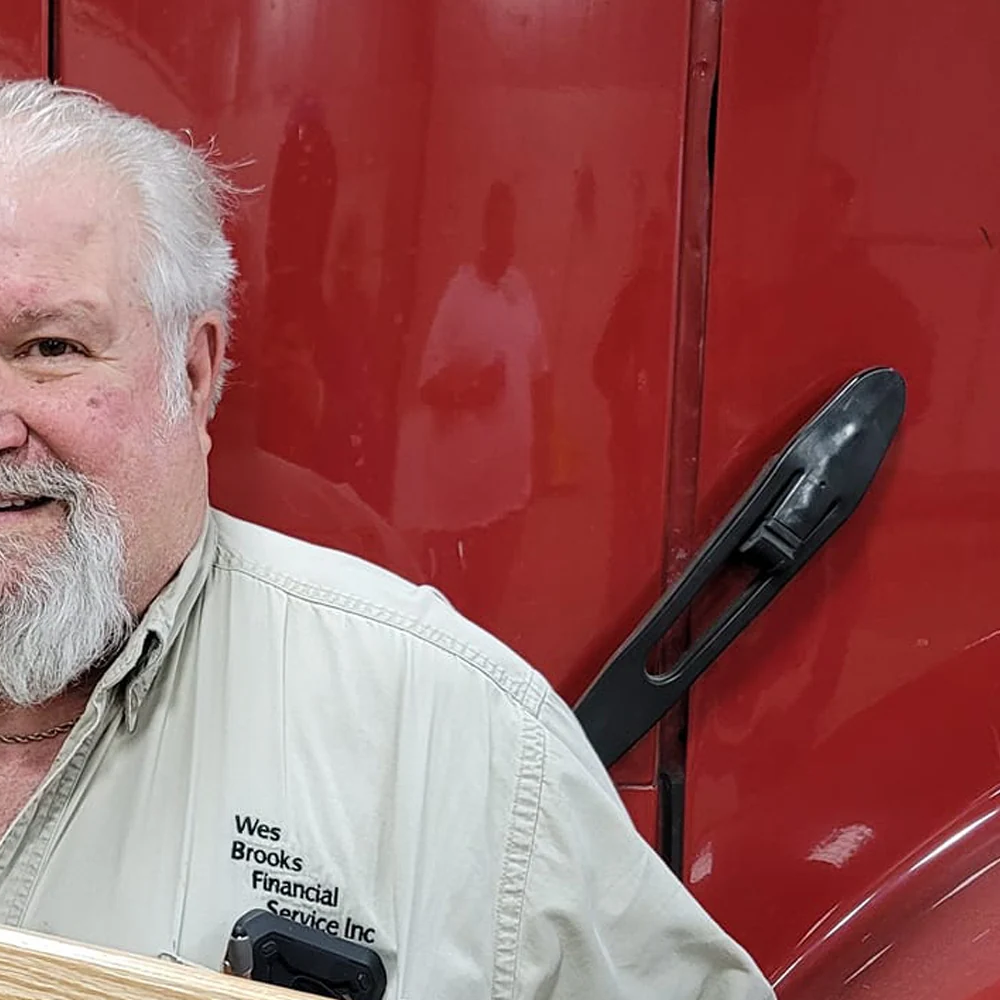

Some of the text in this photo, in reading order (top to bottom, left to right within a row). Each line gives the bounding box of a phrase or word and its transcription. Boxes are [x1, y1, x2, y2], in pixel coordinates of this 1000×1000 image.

[234, 814, 281, 842] Wes
[230, 840, 304, 872] Brooks
[252, 870, 339, 908] Financial
[266, 899, 376, 944] Service Inc
